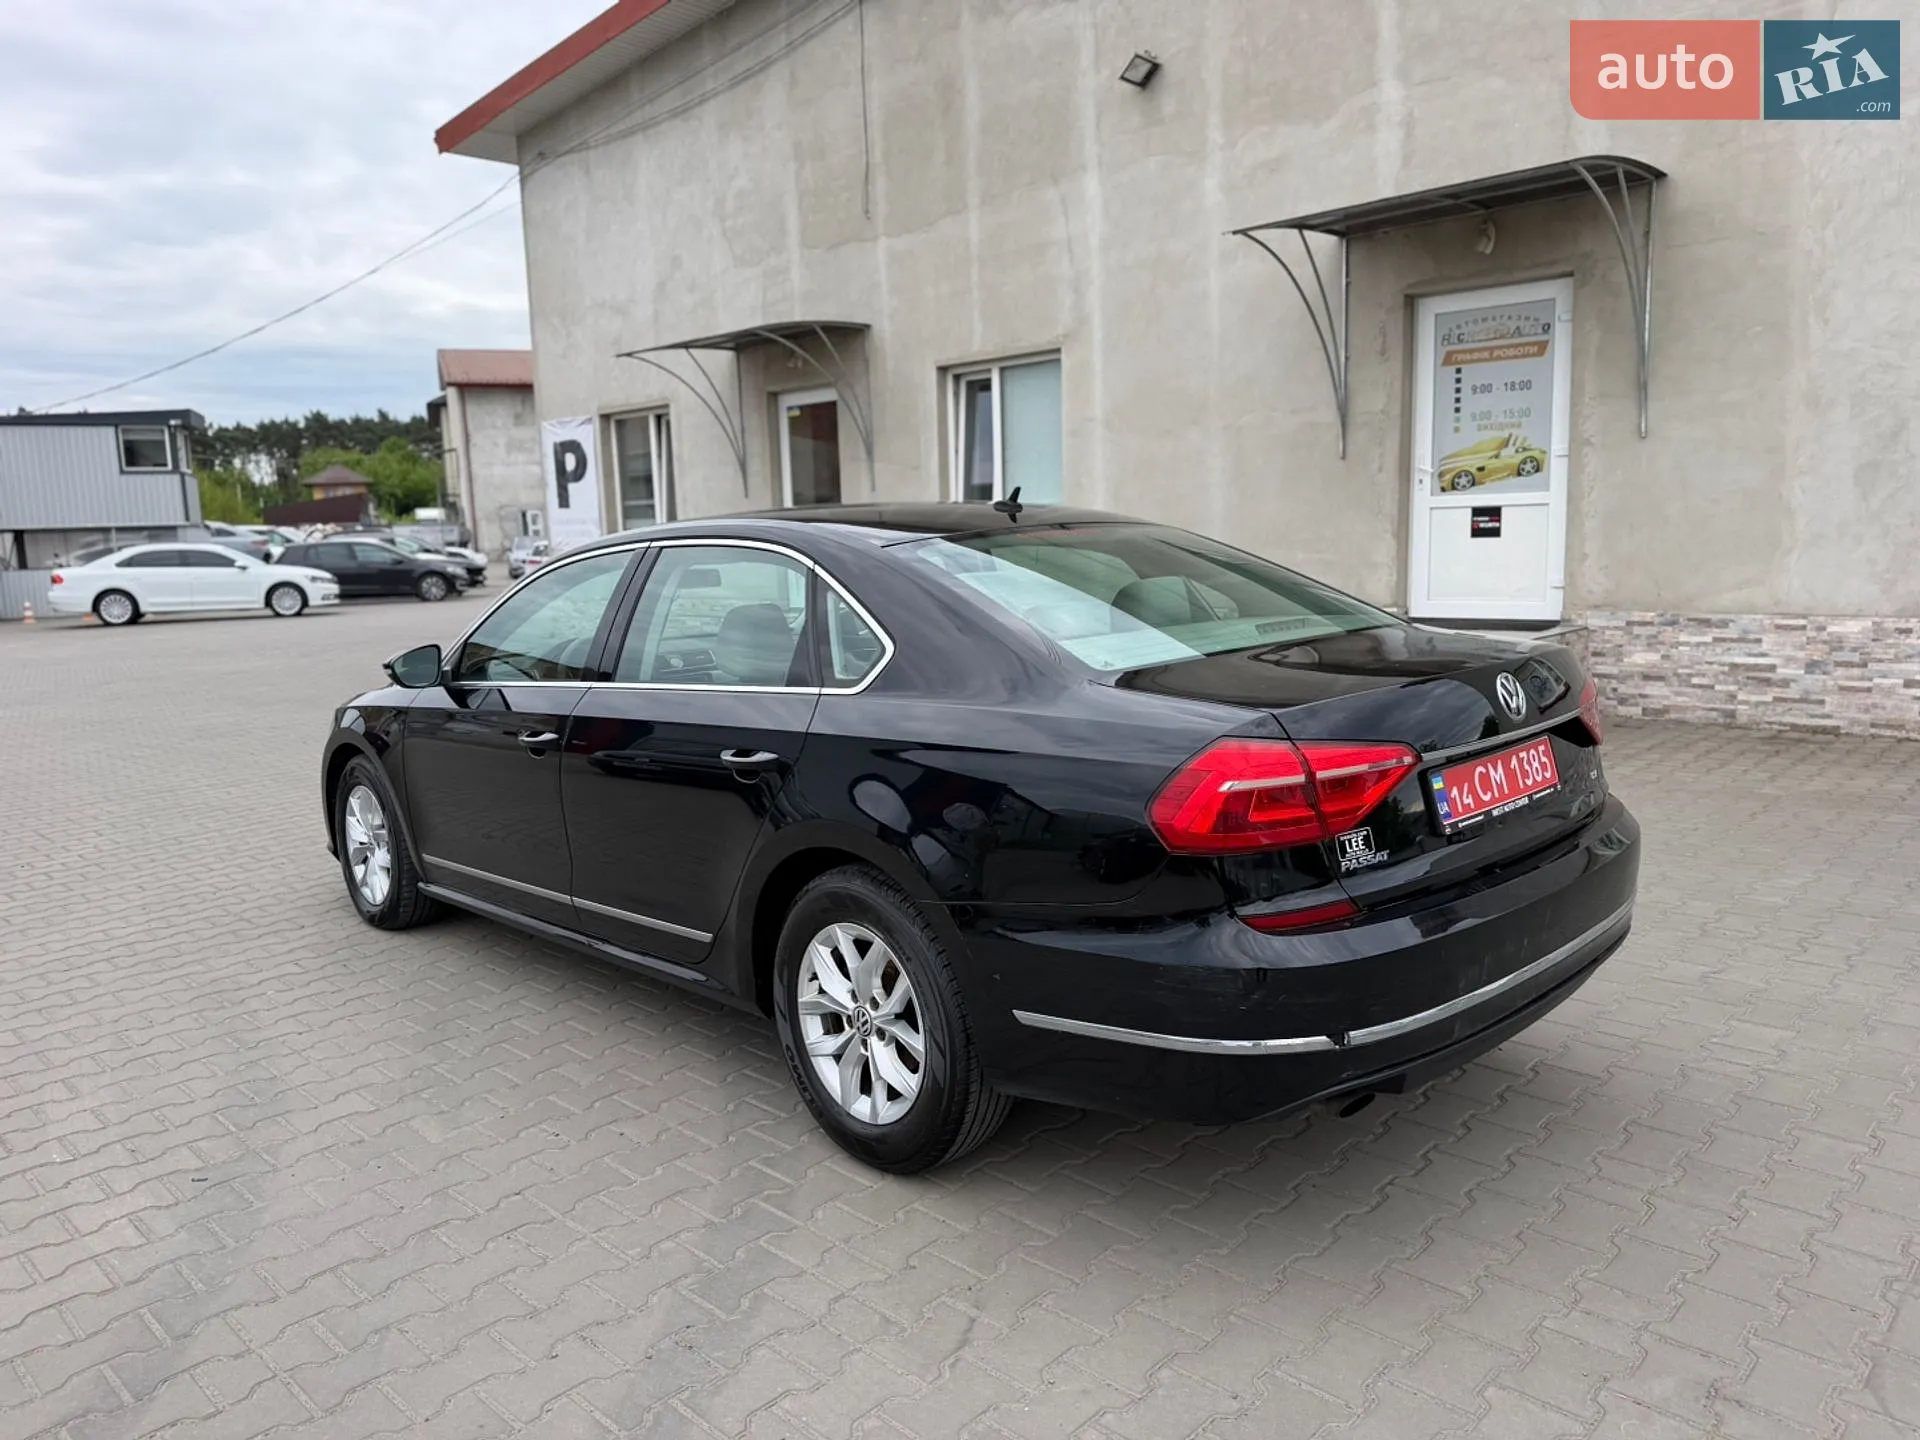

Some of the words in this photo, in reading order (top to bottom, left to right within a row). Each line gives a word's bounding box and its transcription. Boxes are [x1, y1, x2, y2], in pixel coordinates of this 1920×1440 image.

[1470, 383, 1493, 395] 9:00
[1503, 379, 1532, 392] 18:00
[1503, 407, 1532, 420] 15:00
[553, 439, 588, 508] P
[1450, 782, 1474, 813] 14
[1474, 759, 1509, 802] CM
[1510, 745, 1552, 789] 1385
[1437, 801, 1451, 815] UA
[1345, 836, 1366, 852] LEE
[1341, 849, 1390, 873] PASSAT
